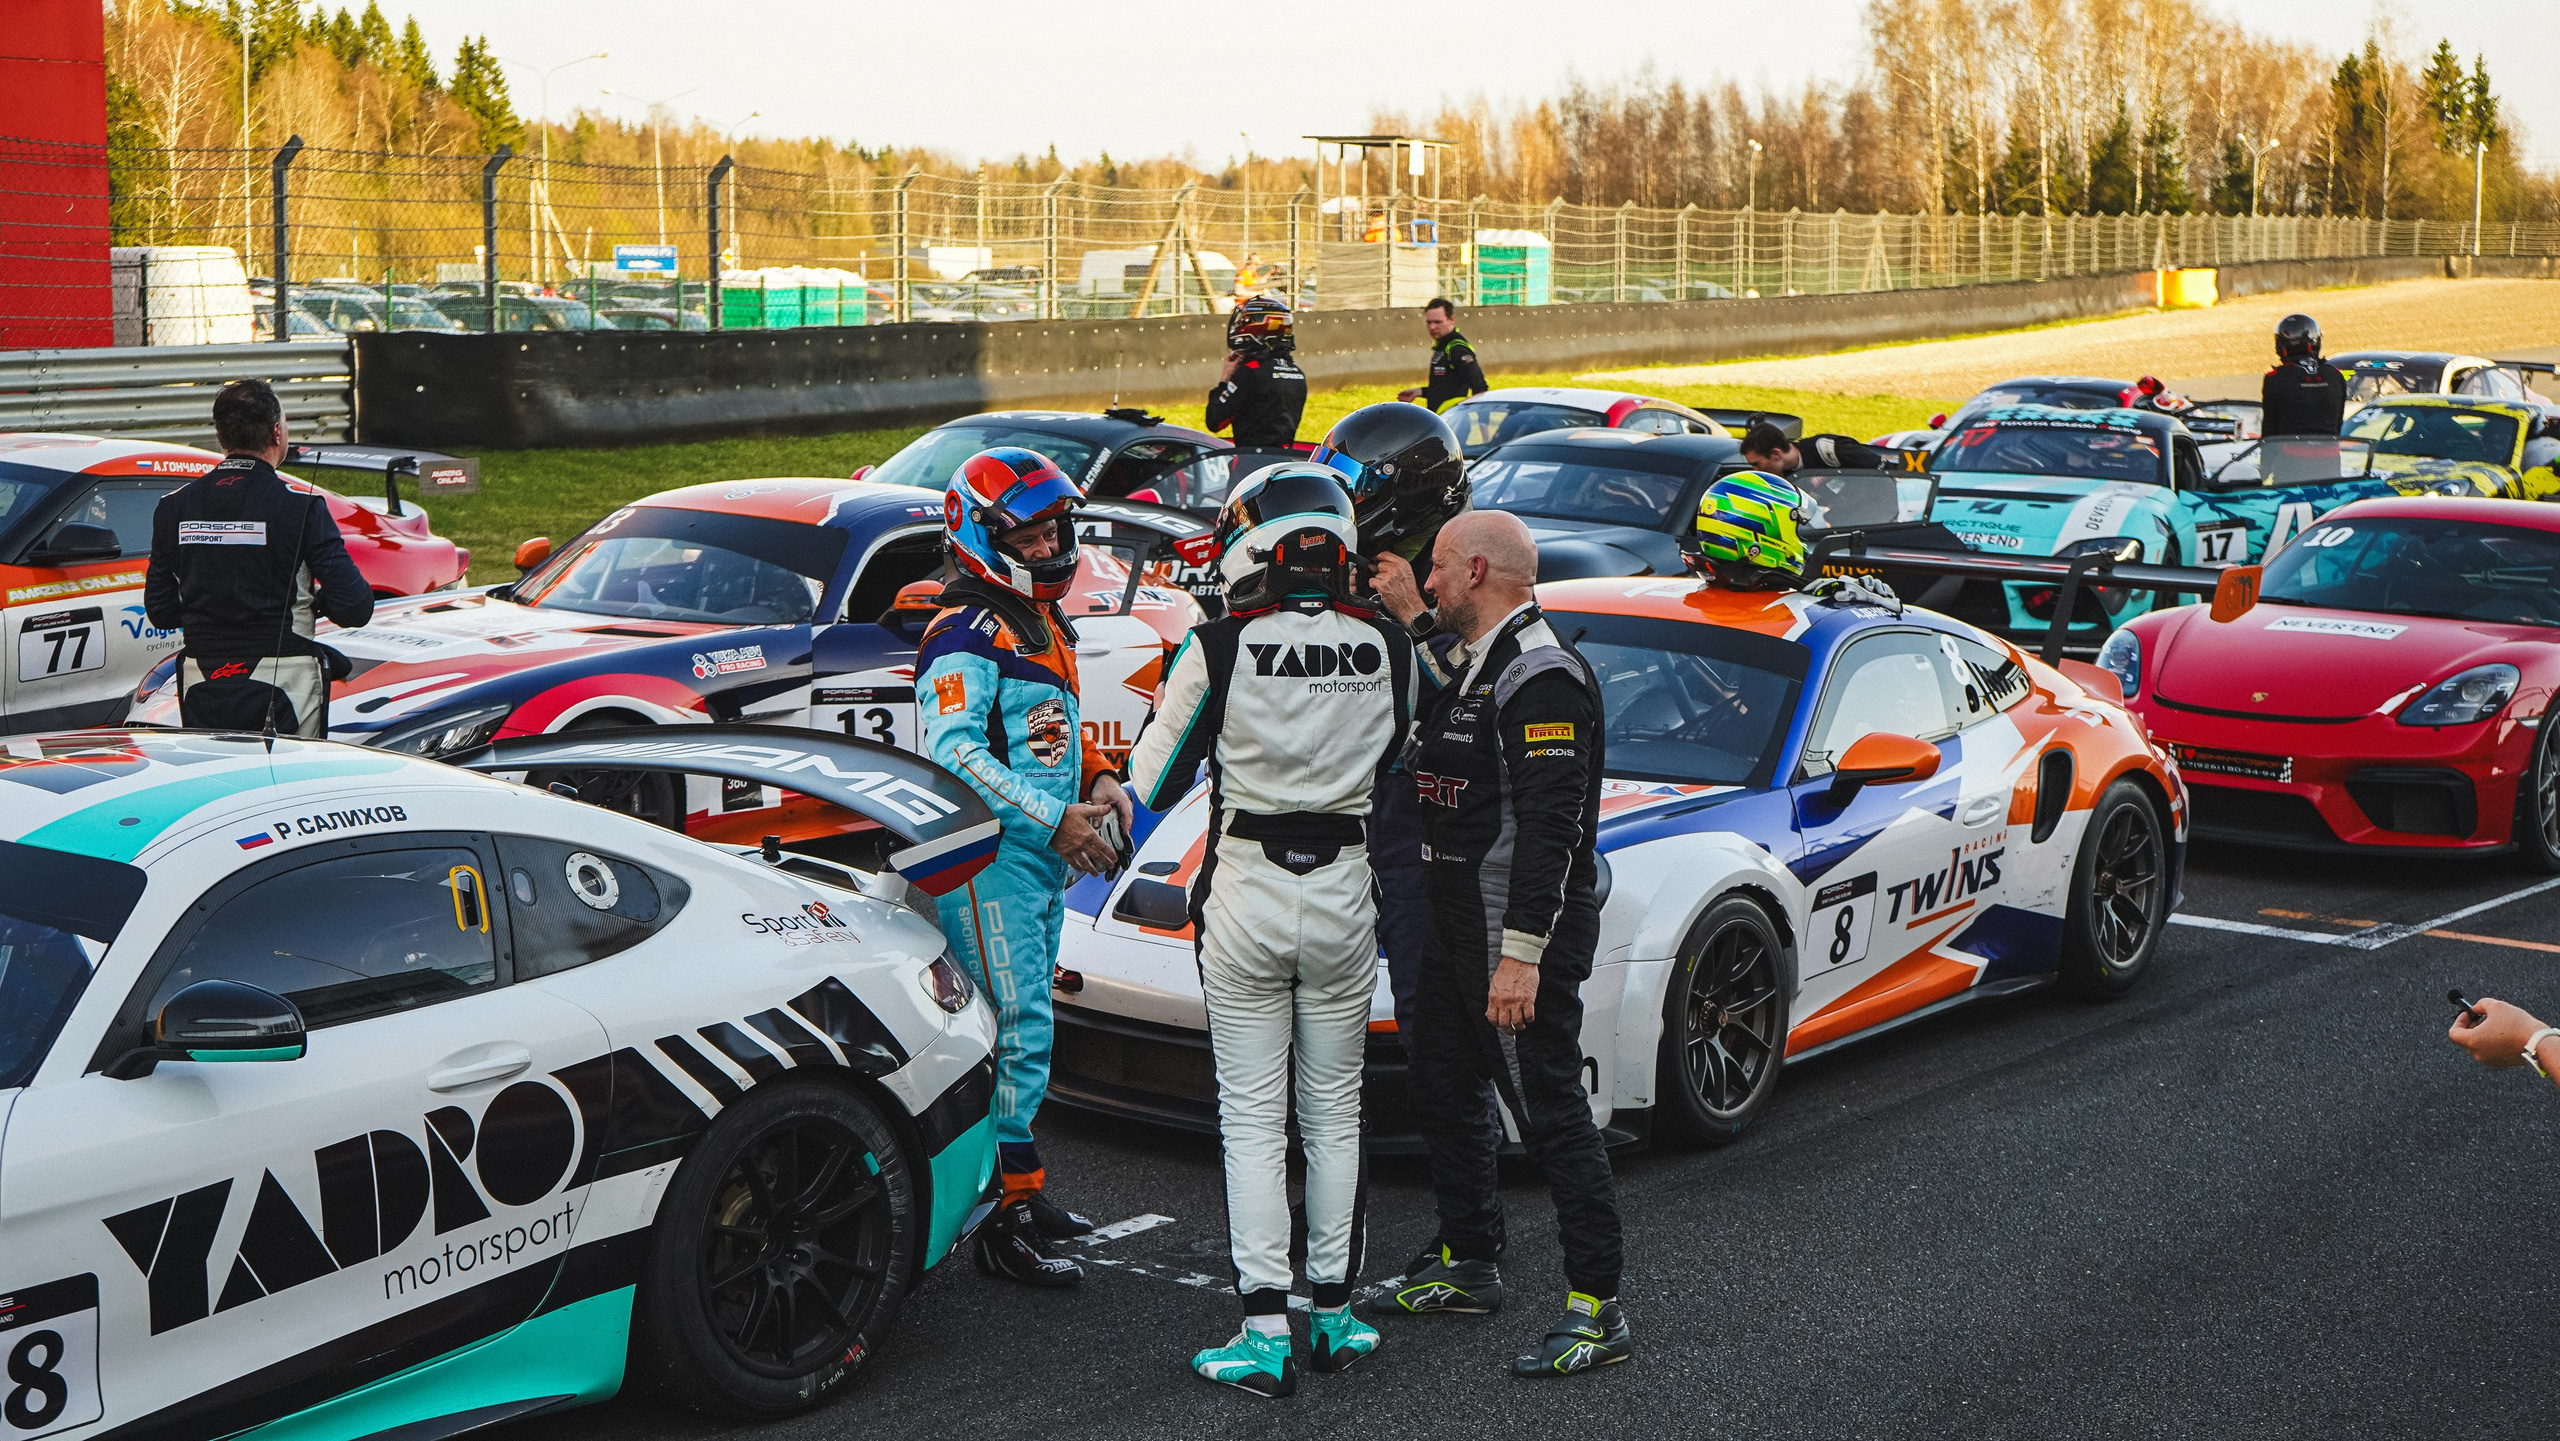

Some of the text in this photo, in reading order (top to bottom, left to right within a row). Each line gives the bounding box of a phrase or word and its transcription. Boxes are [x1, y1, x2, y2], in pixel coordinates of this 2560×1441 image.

[1203, 456, 1230, 483] 64
[1943, 518, 2022, 533] RCTIQUE
[2303, 526, 2355, 547] 10
[2202, 531, 2233, 562] 17
[8, 573, 146, 602] AMAZING ONLINE
[43, 627, 91, 674] 77
[146, 639, 175, 651] cycling
[1245, 642, 1382, 677] YADRO
[1940, 634, 1971, 686] 8
[720, 659, 763, 673] PRO RACING
[1309, 679, 1382, 695] motorsport
[836, 708, 896, 746] 13
[1528, 726, 1571, 739] PIRELLI
[690, 745, 962, 826] AMG
[273, 805, 408, 840] Р.САЛИХОВ
[1286, 850, 1317, 863] freem
[1964, 829, 2008, 855] RACING
[1887, 846, 2005, 924] TWINS
[741, 913, 819, 936] Sport
[958, 905, 978, 957] SPORT
[1829, 905, 1854, 964] 8
[983, 900, 1023, 1118] PORSCHE
[102, 1080, 577, 1337] YADRO
[385, 1201, 575, 1300] motorsport
[1248, 1339, 1270, 1352] ULES
[0, 1329, 68, 1430] 8
